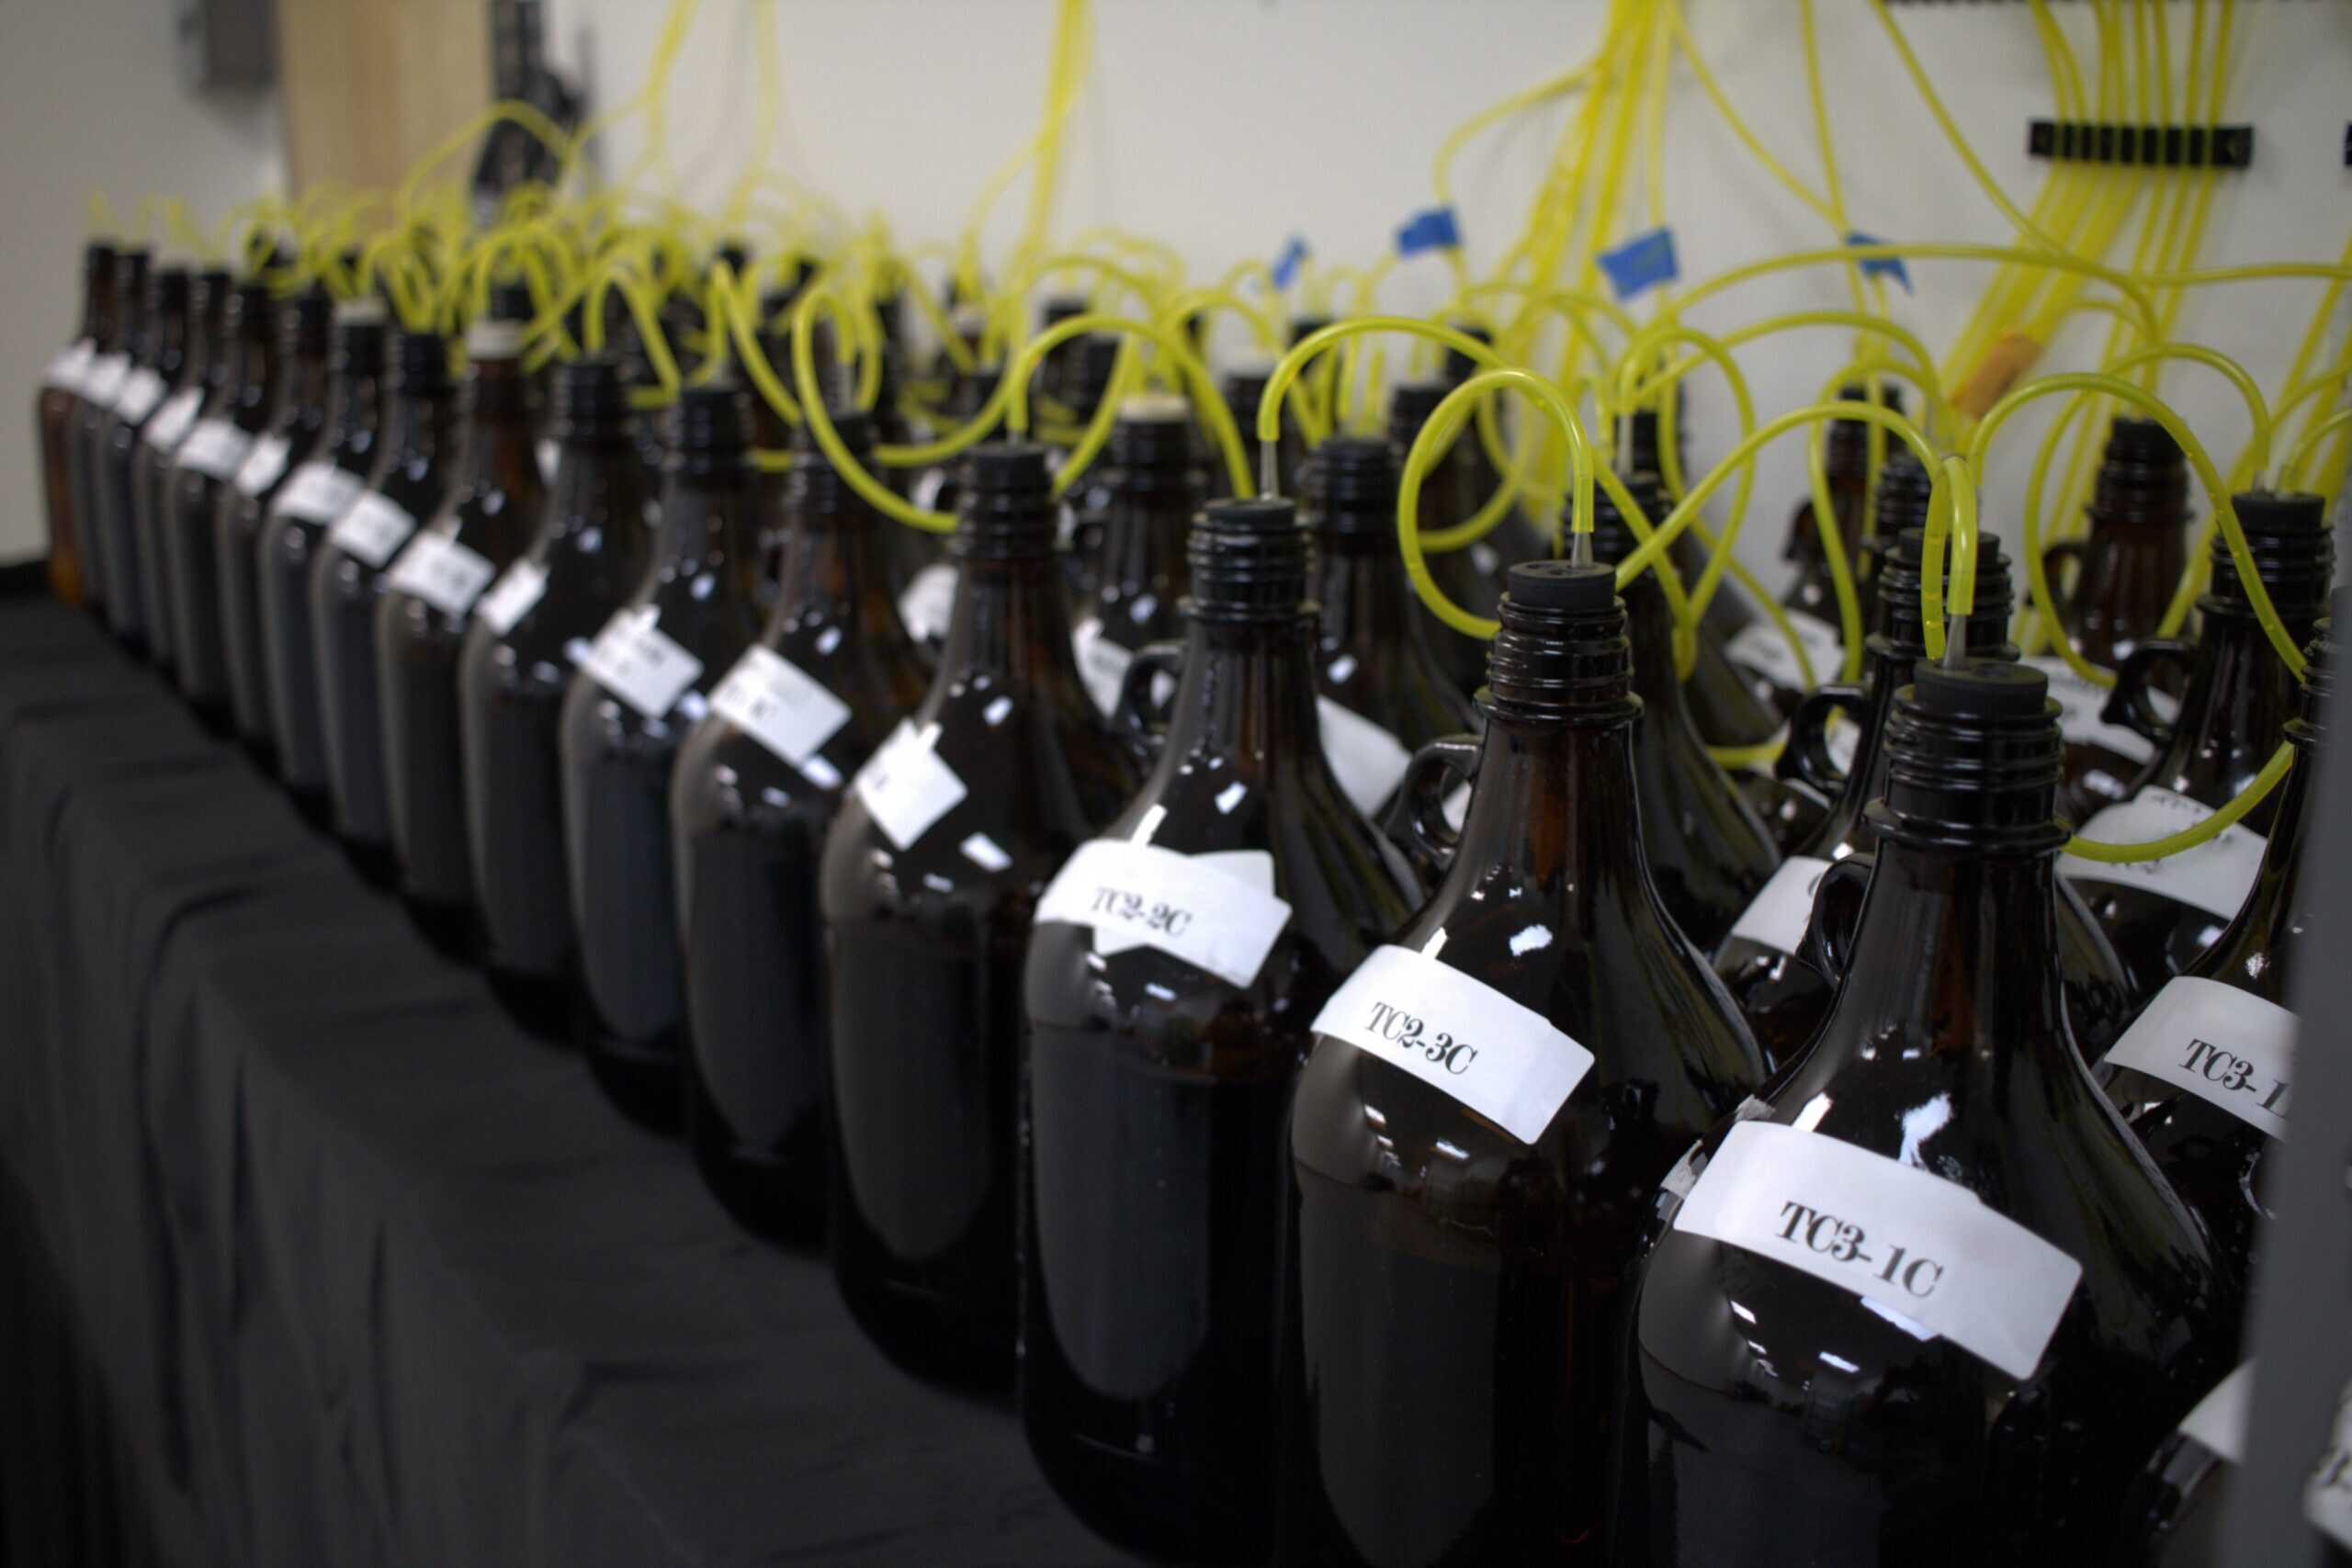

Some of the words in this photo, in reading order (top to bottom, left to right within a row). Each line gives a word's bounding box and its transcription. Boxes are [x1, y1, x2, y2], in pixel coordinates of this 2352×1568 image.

[1091, 886, 1193, 937] TC2-2C
[1364, 1000, 1478, 1075] TC2-3C
[1775, 1201, 1944, 1298] TC3-1C
